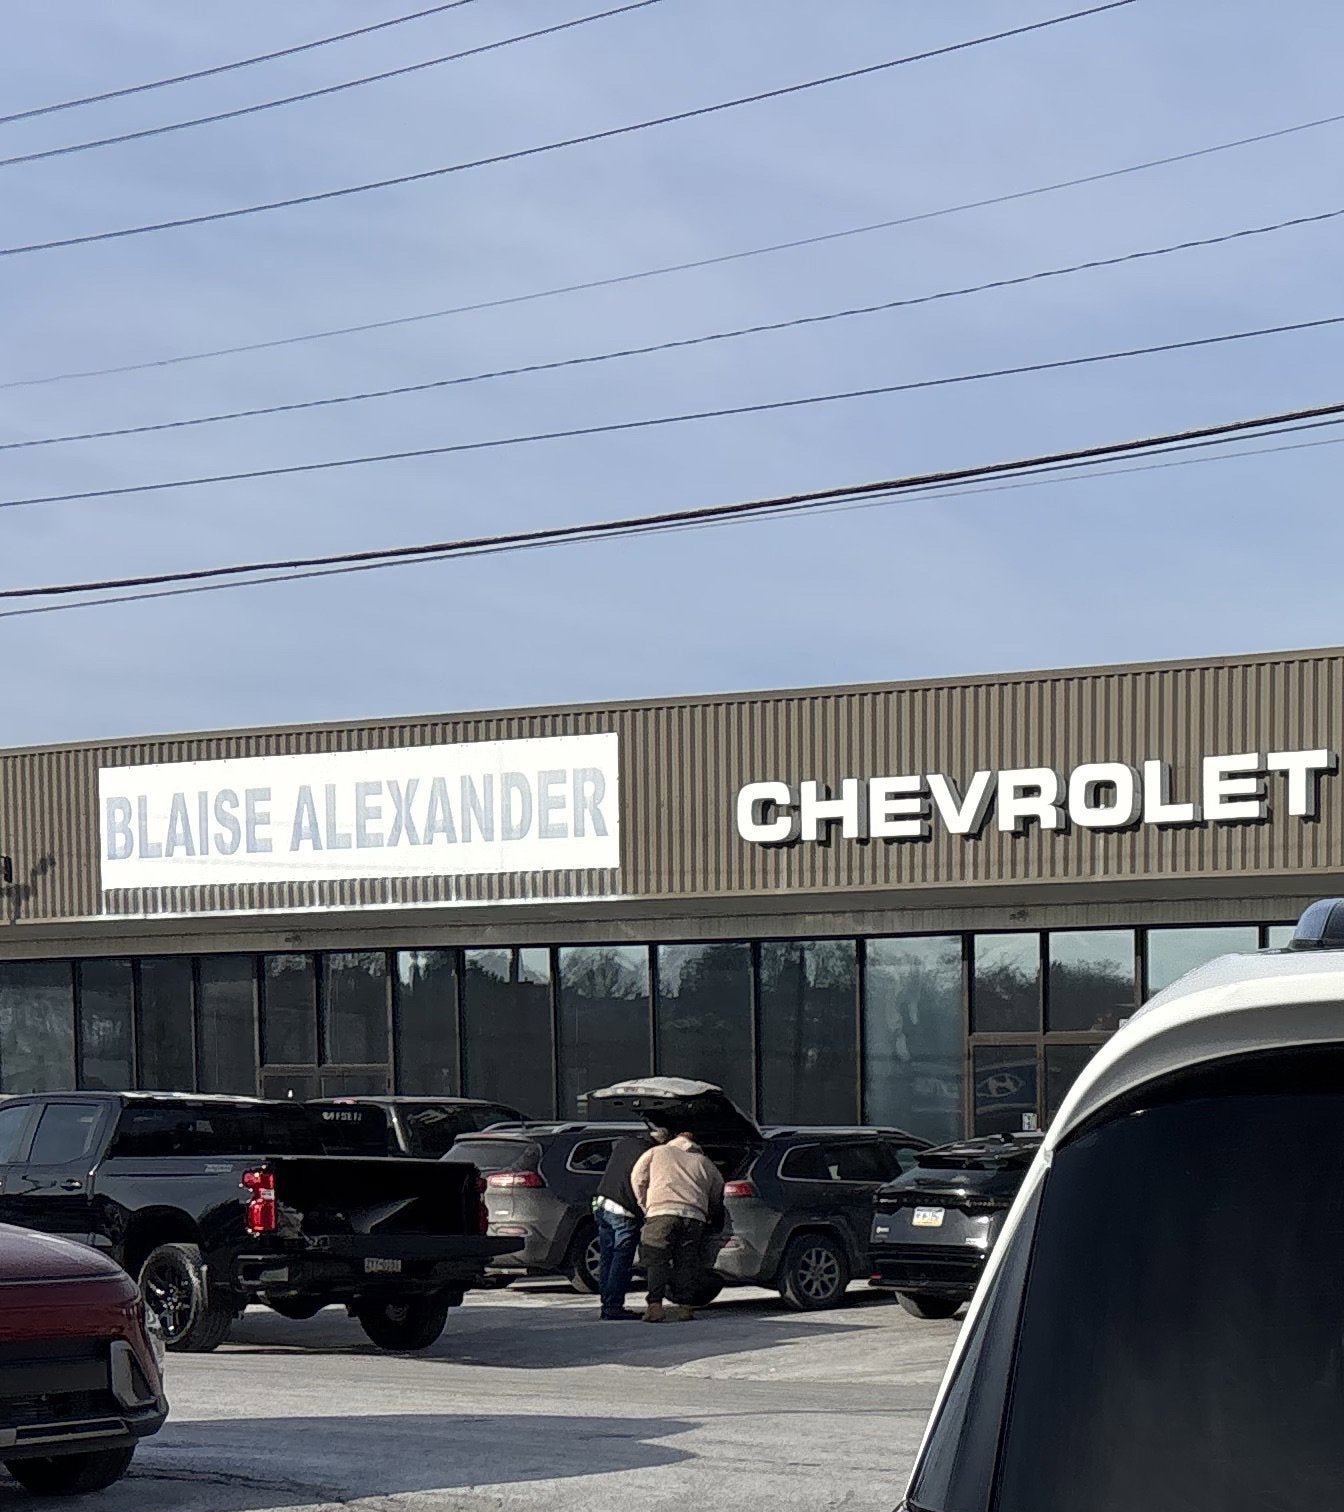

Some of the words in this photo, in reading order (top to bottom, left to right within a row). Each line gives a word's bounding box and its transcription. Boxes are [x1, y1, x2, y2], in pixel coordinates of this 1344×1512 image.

[106, 787, 273, 860] BLAISE
[289, 766, 609, 853] ALEXANDER
[736, 748, 1333, 845] CHEVROLET
